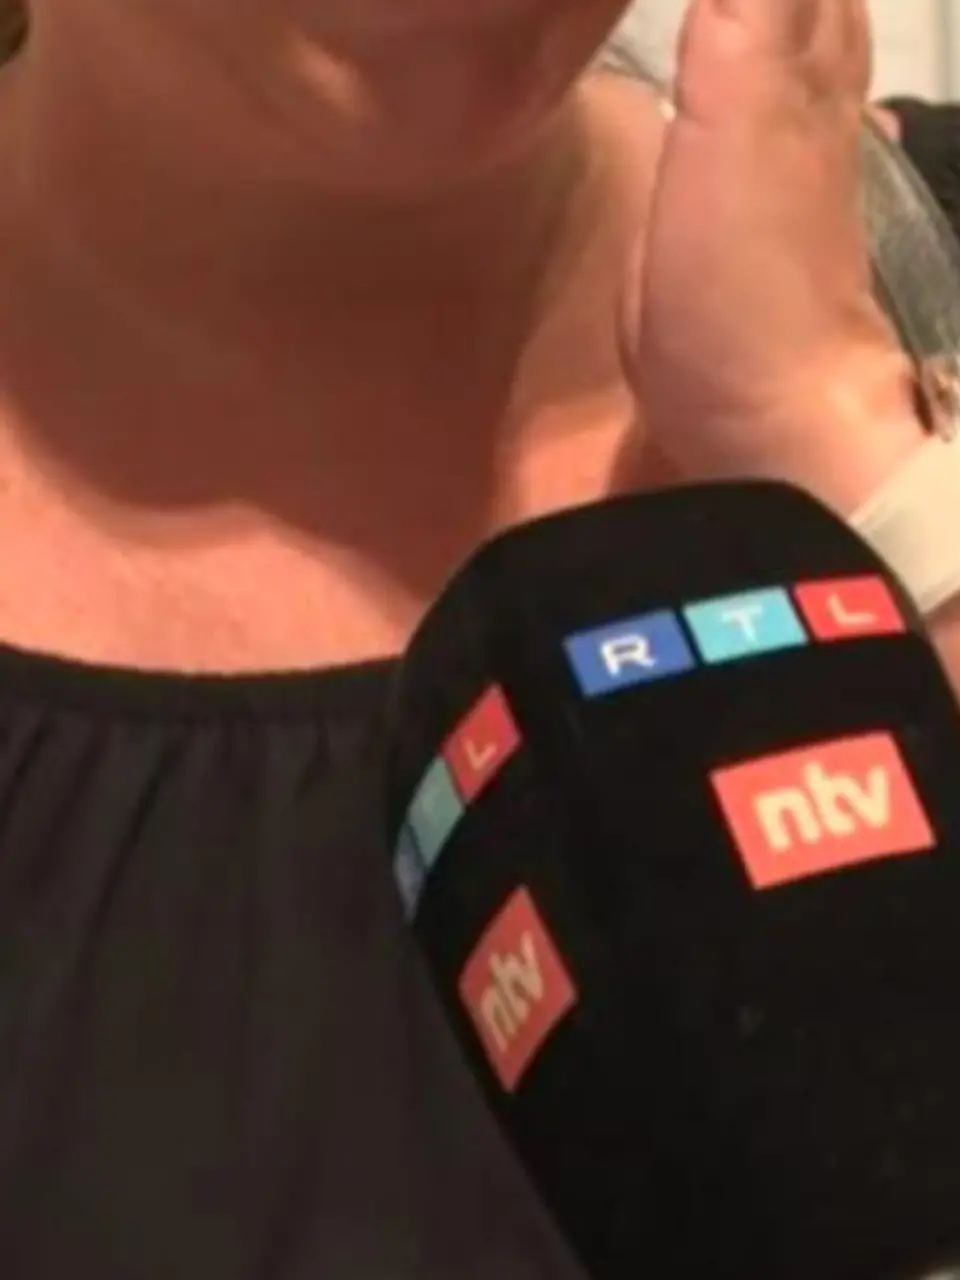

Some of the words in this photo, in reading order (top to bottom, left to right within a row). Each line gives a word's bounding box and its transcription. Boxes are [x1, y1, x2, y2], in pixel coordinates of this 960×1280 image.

[601, 592, 876, 676] RTL
[755, 761, 890, 853] ntv
[480, 930, 543, 1052] ntv
